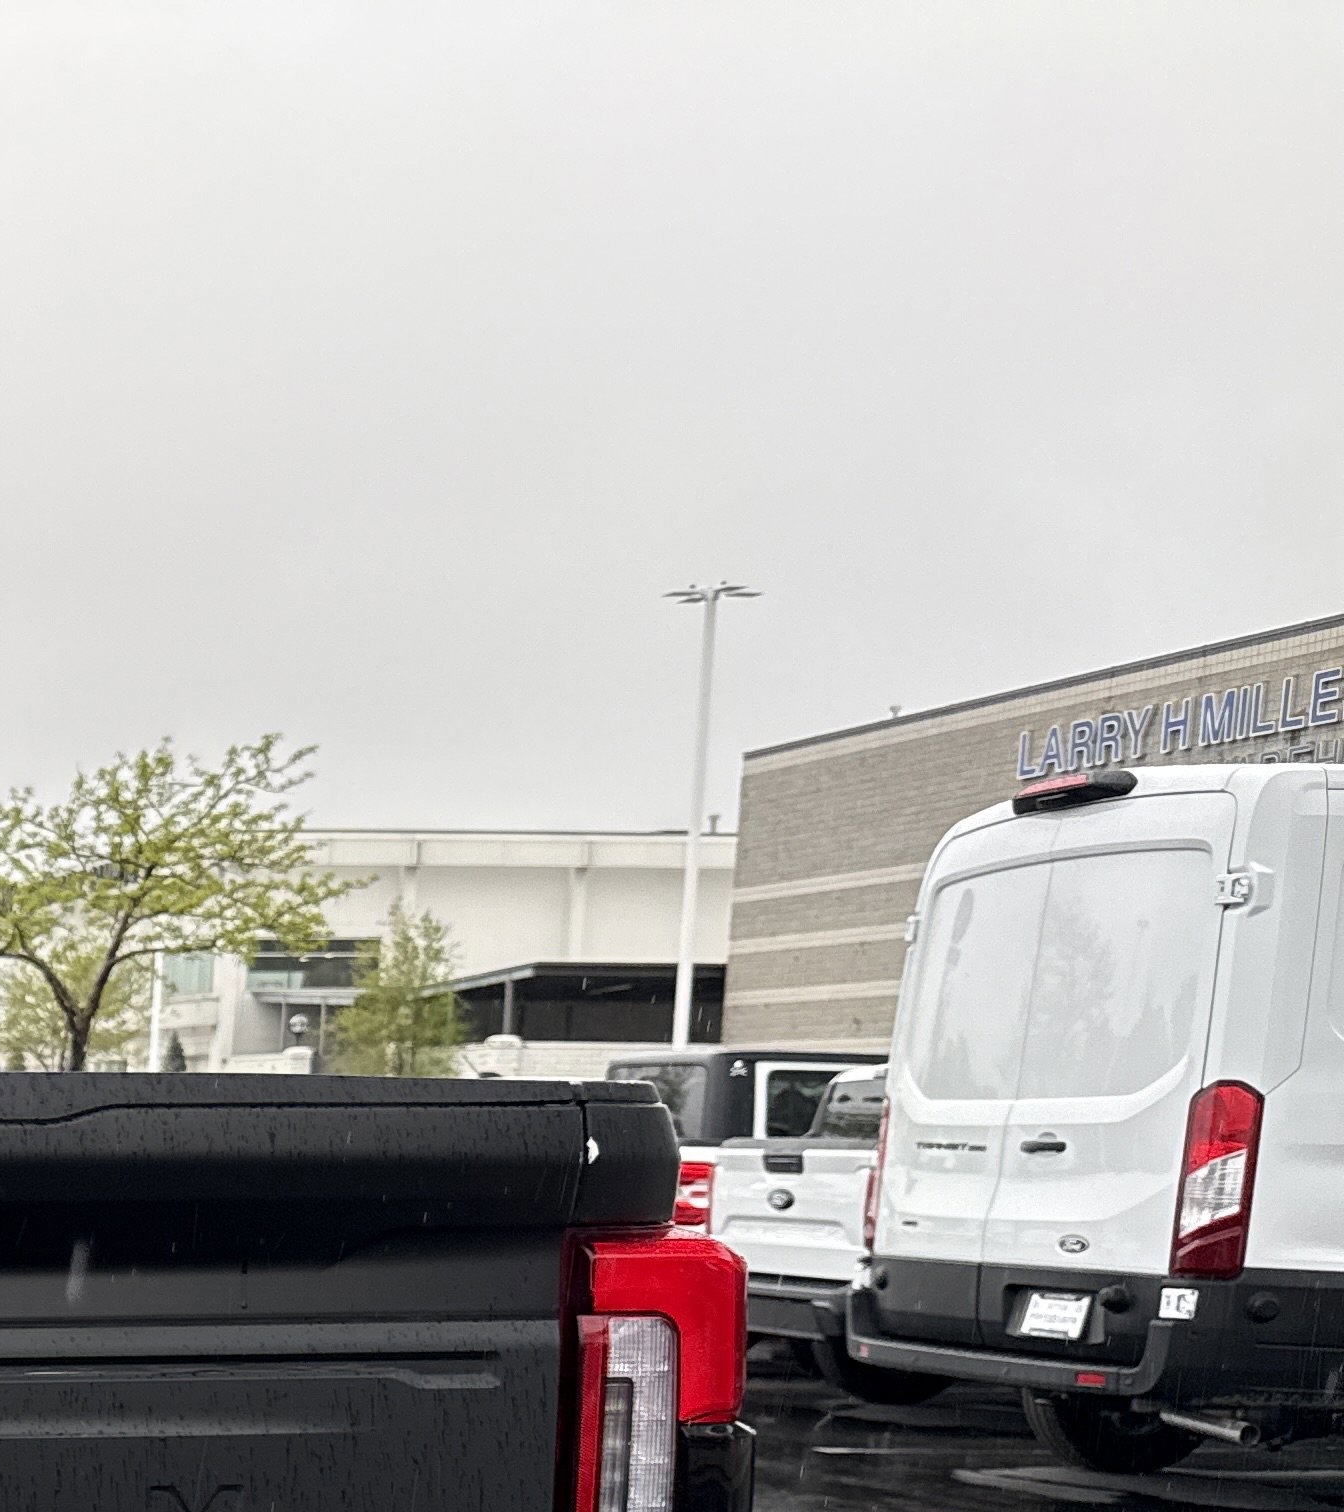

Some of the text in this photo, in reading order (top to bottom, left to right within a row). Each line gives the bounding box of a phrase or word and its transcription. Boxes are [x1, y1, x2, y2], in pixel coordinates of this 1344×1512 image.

[1016, 667, 1344, 780] LARRY H MILLE
